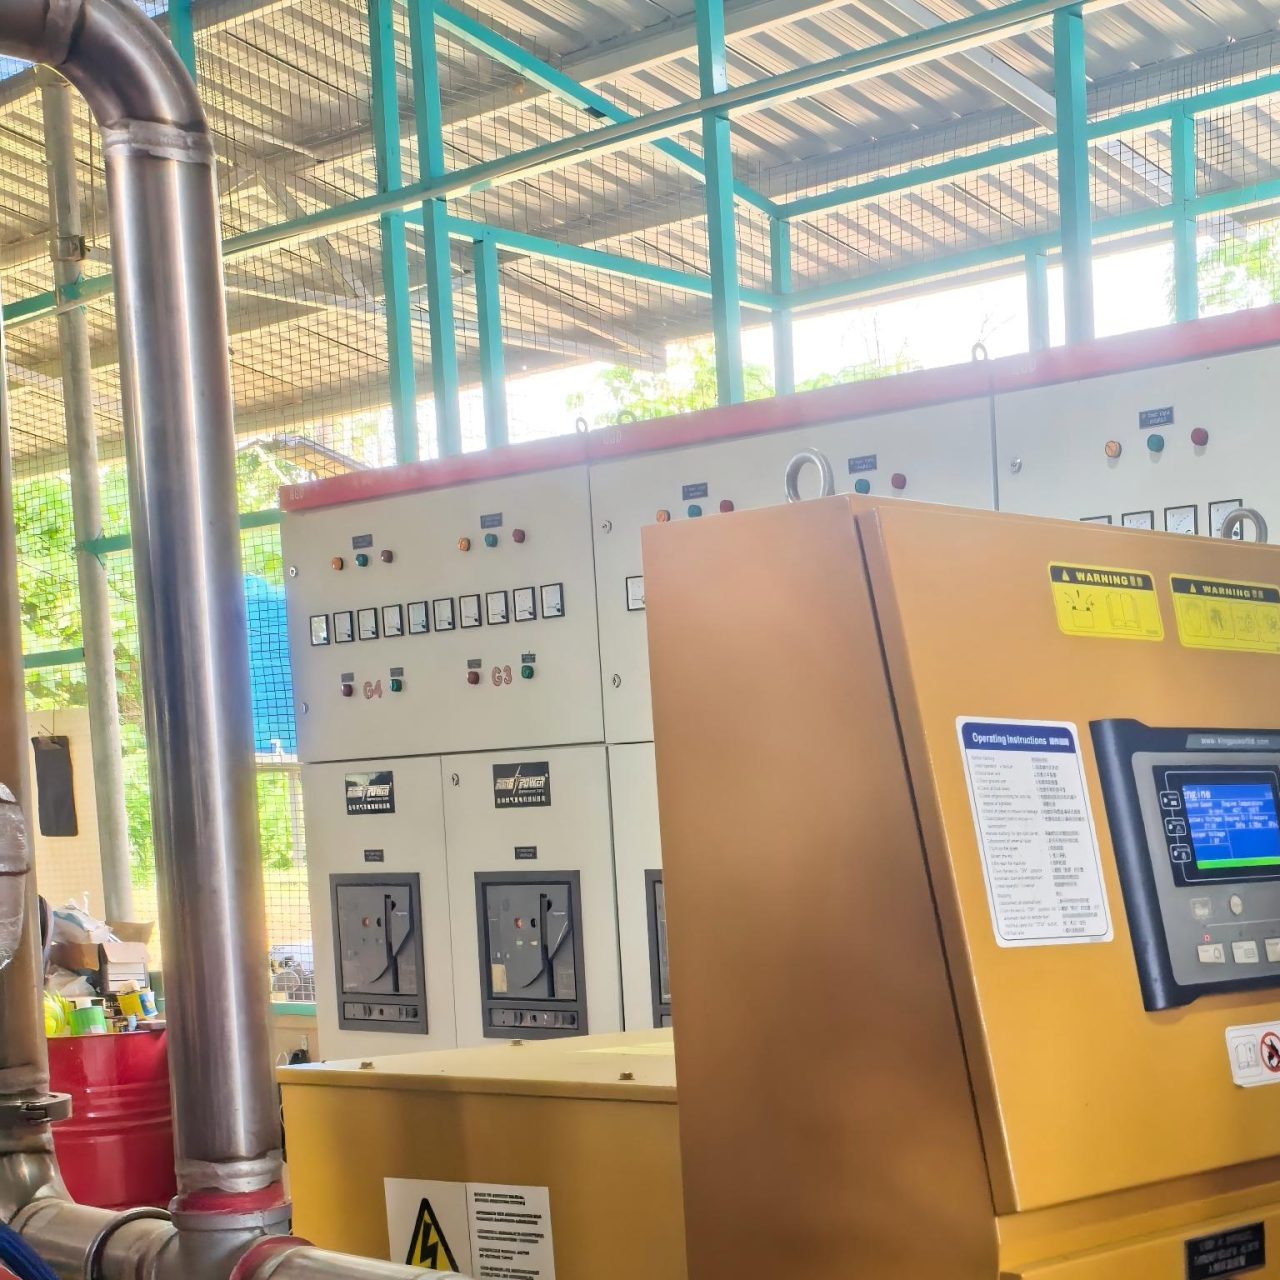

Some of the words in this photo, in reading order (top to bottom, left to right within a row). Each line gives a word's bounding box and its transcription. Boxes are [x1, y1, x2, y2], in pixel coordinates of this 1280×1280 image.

[1075, 570, 1129, 587] WARNING
[1202, 584, 1251, 599] WARNING
[491, 664, 513, 687] G3
[363, 680, 383, 700] G4
[972, 732, 1007, 746] Operating
